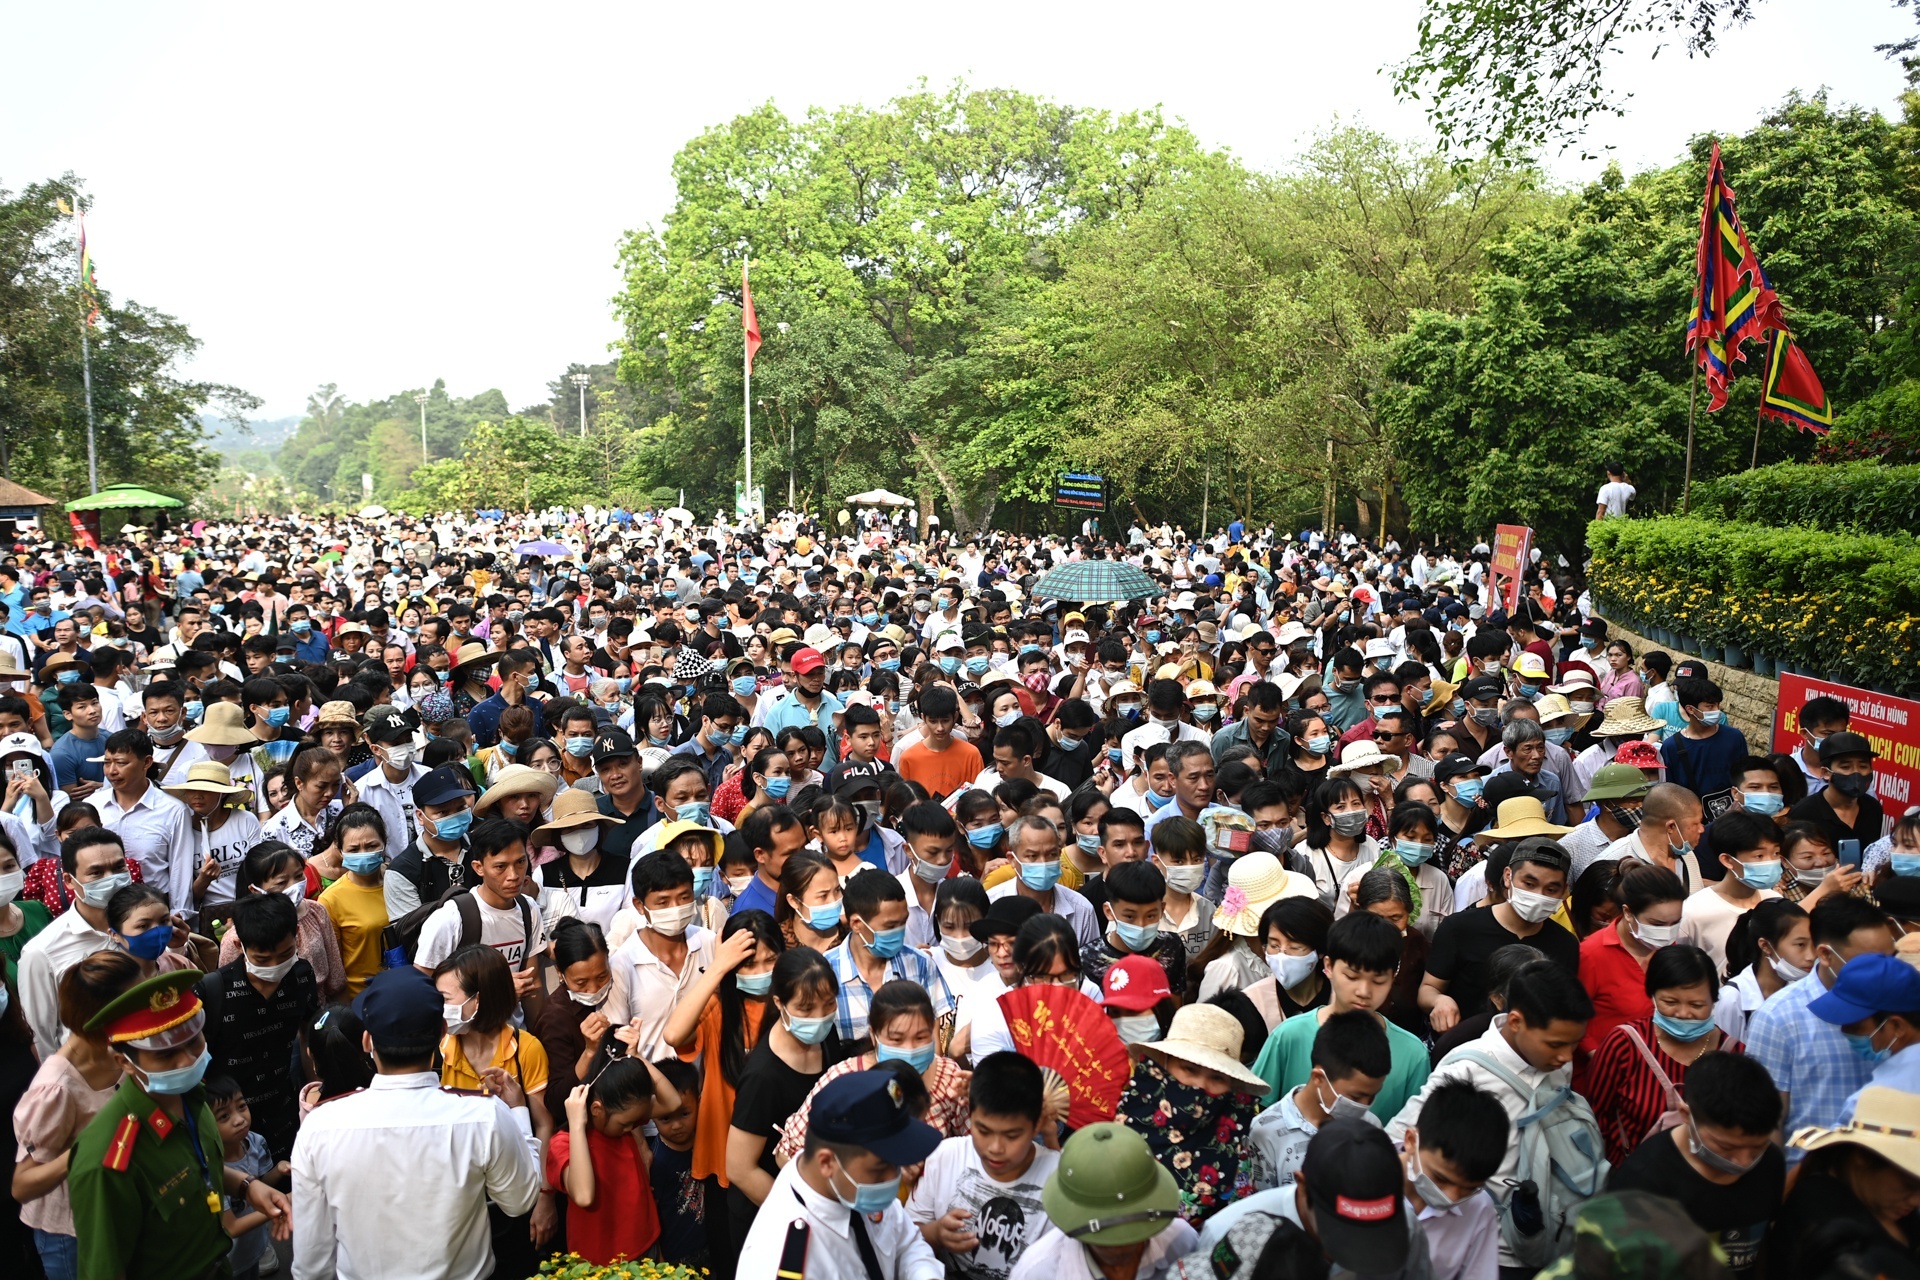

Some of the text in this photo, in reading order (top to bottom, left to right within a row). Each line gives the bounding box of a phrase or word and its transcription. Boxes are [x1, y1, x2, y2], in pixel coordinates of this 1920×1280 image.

[1805, 688, 1819, 701] KHU
[1860, 697, 1871, 716] SỬ
[1870, 700, 1886, 720] ĐỀN
[1887, 705, 1908, 726] HÙNG
[387, 714, 405, 728] NY
[1784, 706, 1798, 733] ĐỂ
[1868, 735, 1893, 761] DỊCH
[602, 737, 615, 752] NY
[843, 766, 870, 780] FILA
[1879, 772, 1910, 803] KHÁCH
[193, 840, 248, 871] GRLS?
[1180, 931, 1210, 944] ARED
[1341, 1200, 1392, 1218] Supreme
